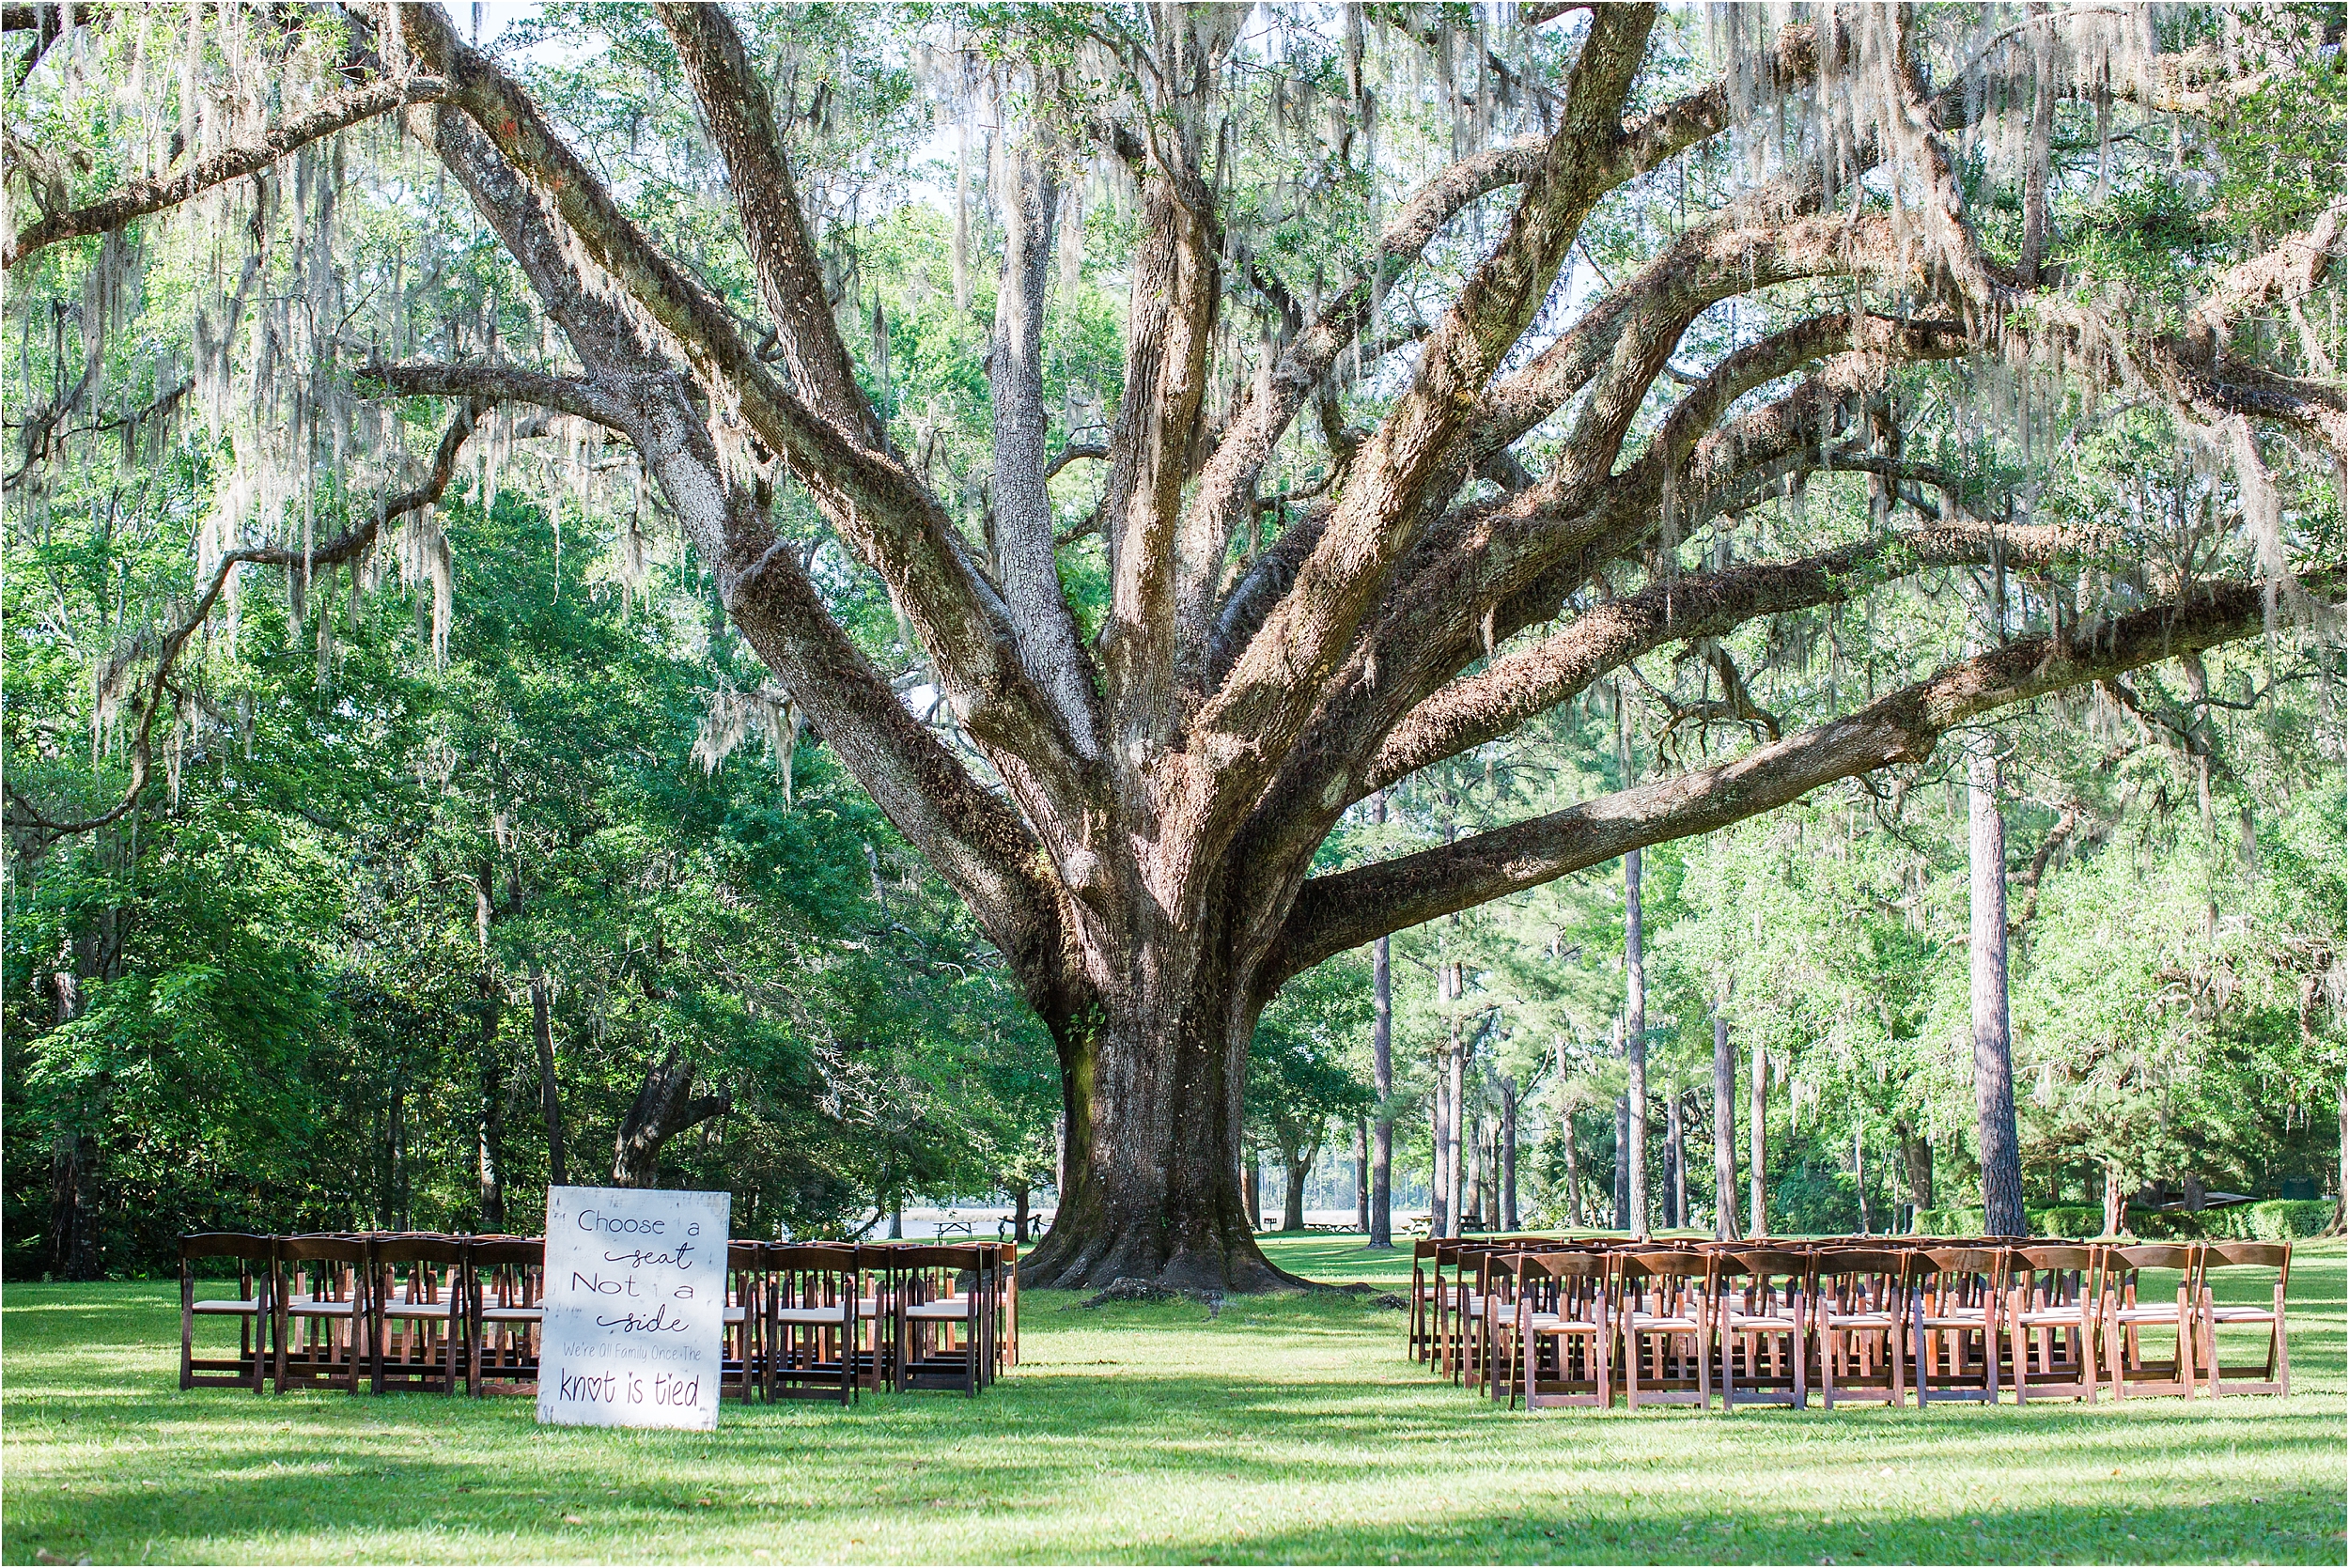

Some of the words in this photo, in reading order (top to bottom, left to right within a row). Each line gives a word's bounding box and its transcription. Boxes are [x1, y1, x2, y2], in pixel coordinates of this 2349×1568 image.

[578, 1209, 665, 1234] Choose
[688, 1221, 700, 1236] a
[604, 1242, 694, 1269] seat
[571, 1271, 640, 1297] Not
[674, 1285, 693, 1299] a
[597, 1303, 689, 1332] side
[563, 1342, 595, 1358] We're
[615, 1343, 647, 1363] Family
[652, 1344, 677, 1360] Once
[627, 1371, 643, 1404] is
[655, 1373, 699, 1406] tied
